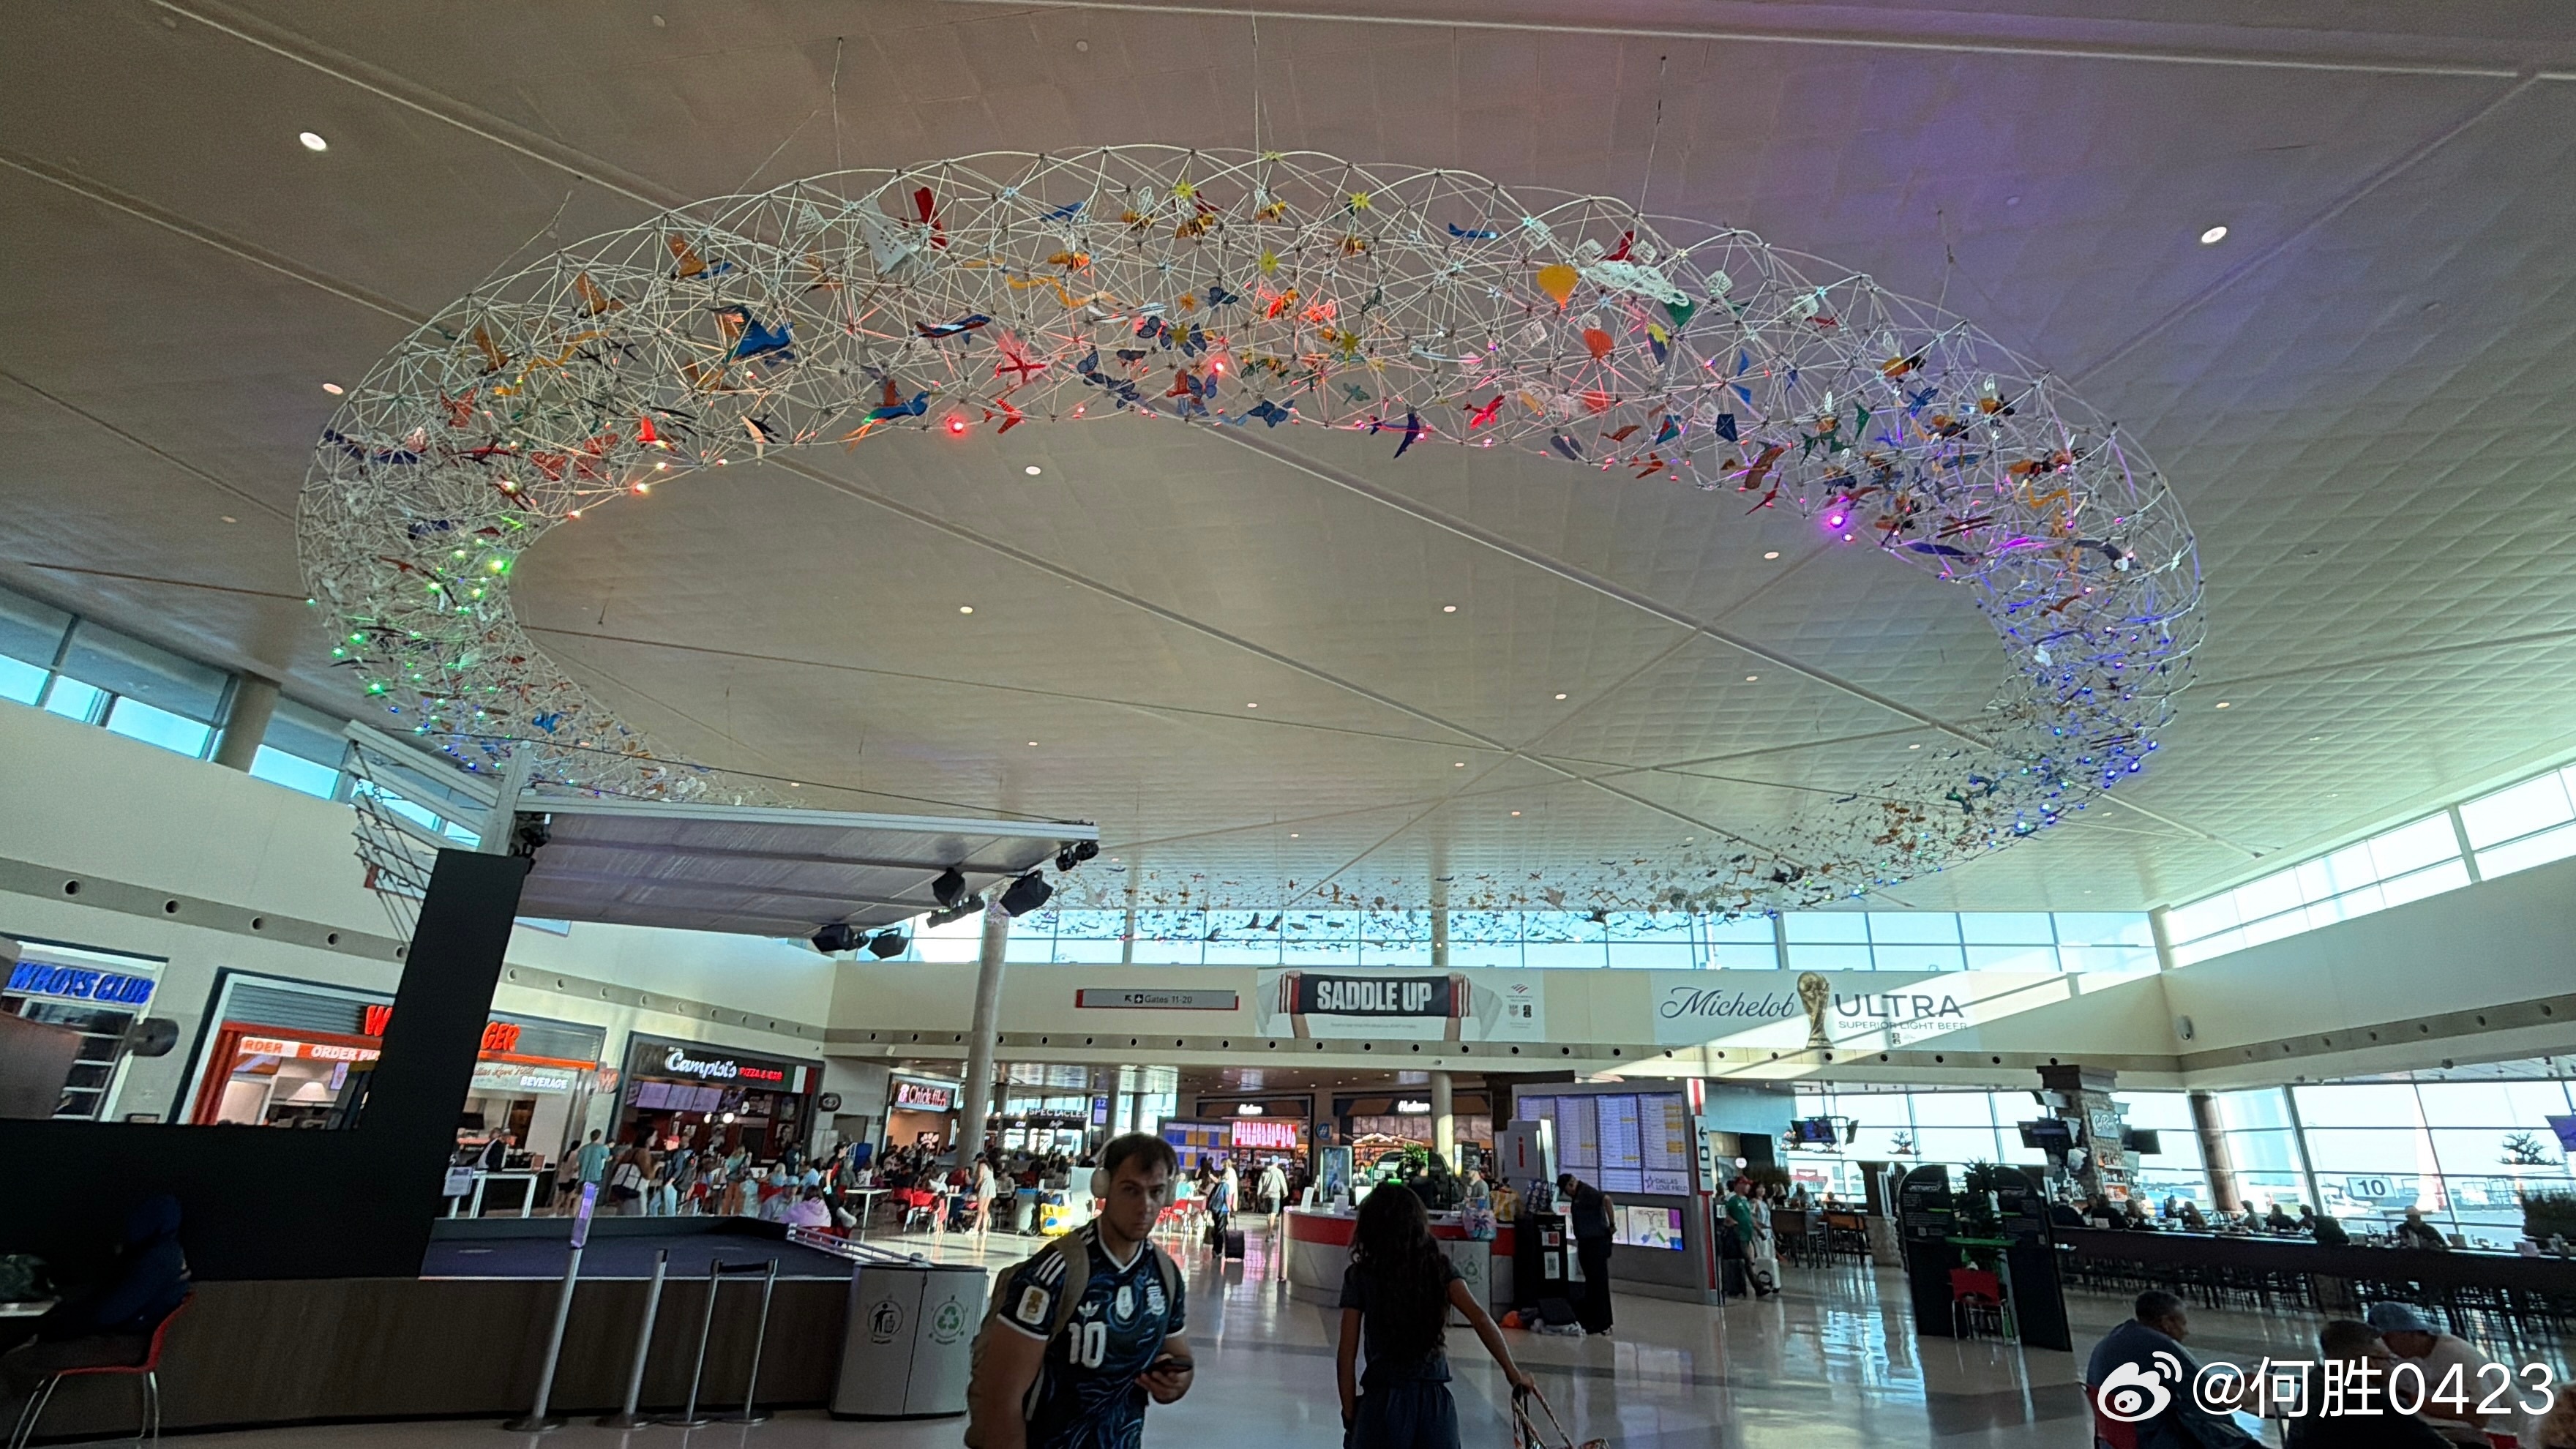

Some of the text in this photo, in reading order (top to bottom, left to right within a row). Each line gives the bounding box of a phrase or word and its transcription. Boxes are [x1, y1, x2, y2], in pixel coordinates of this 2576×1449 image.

[1145, 995, 1192, 1003] Gates 11-20
[1317, 981, 1432, 1011] SADDLE UP
[1660, 986, 1795, 1019] Michelob
[1834, 993, 1965, 1018] ULTRA
[1838, 1021, 1967, 1030] SUPERIOR LIGHT BEER
[311, 1045, 357, 1060] ORDER
[666, 1051, 737, 1079] Campisi's
[738, 1067, 760, 1078] PIZZA
[520, 1074, 568, 1090] BEVERAGE
[1096, 1099, 1107, 1107] 12
[1028, 1107, 1088, 1118] SPECTACLES
[2358, 1179, 2386, 1196] 10
[1068, 1321, 1107, 1368] 10
